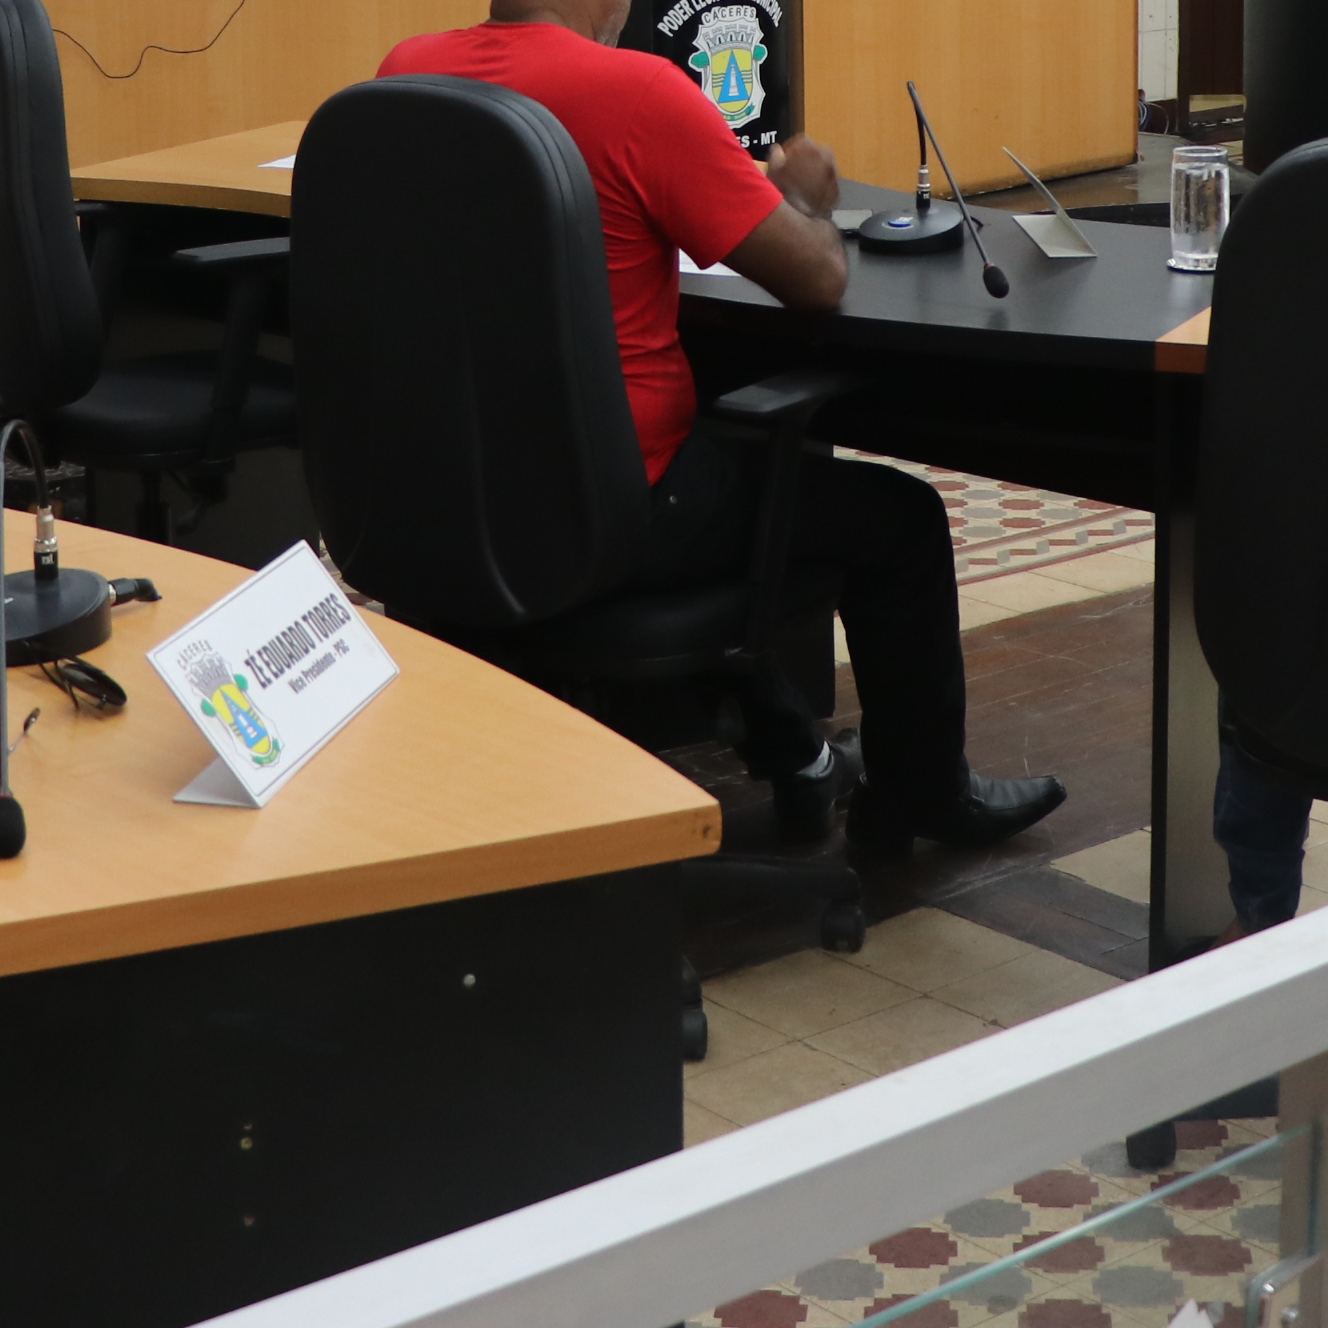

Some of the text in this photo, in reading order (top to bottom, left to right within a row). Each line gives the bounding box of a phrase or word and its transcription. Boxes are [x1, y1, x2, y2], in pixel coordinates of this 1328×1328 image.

[657, 0, 695, 37] PODER
[761, 131, 777, 145] MT
[244, 593, 352, 689] ZÉ EDUARDO TORRES
[288, 677, 307, 694] Vice
